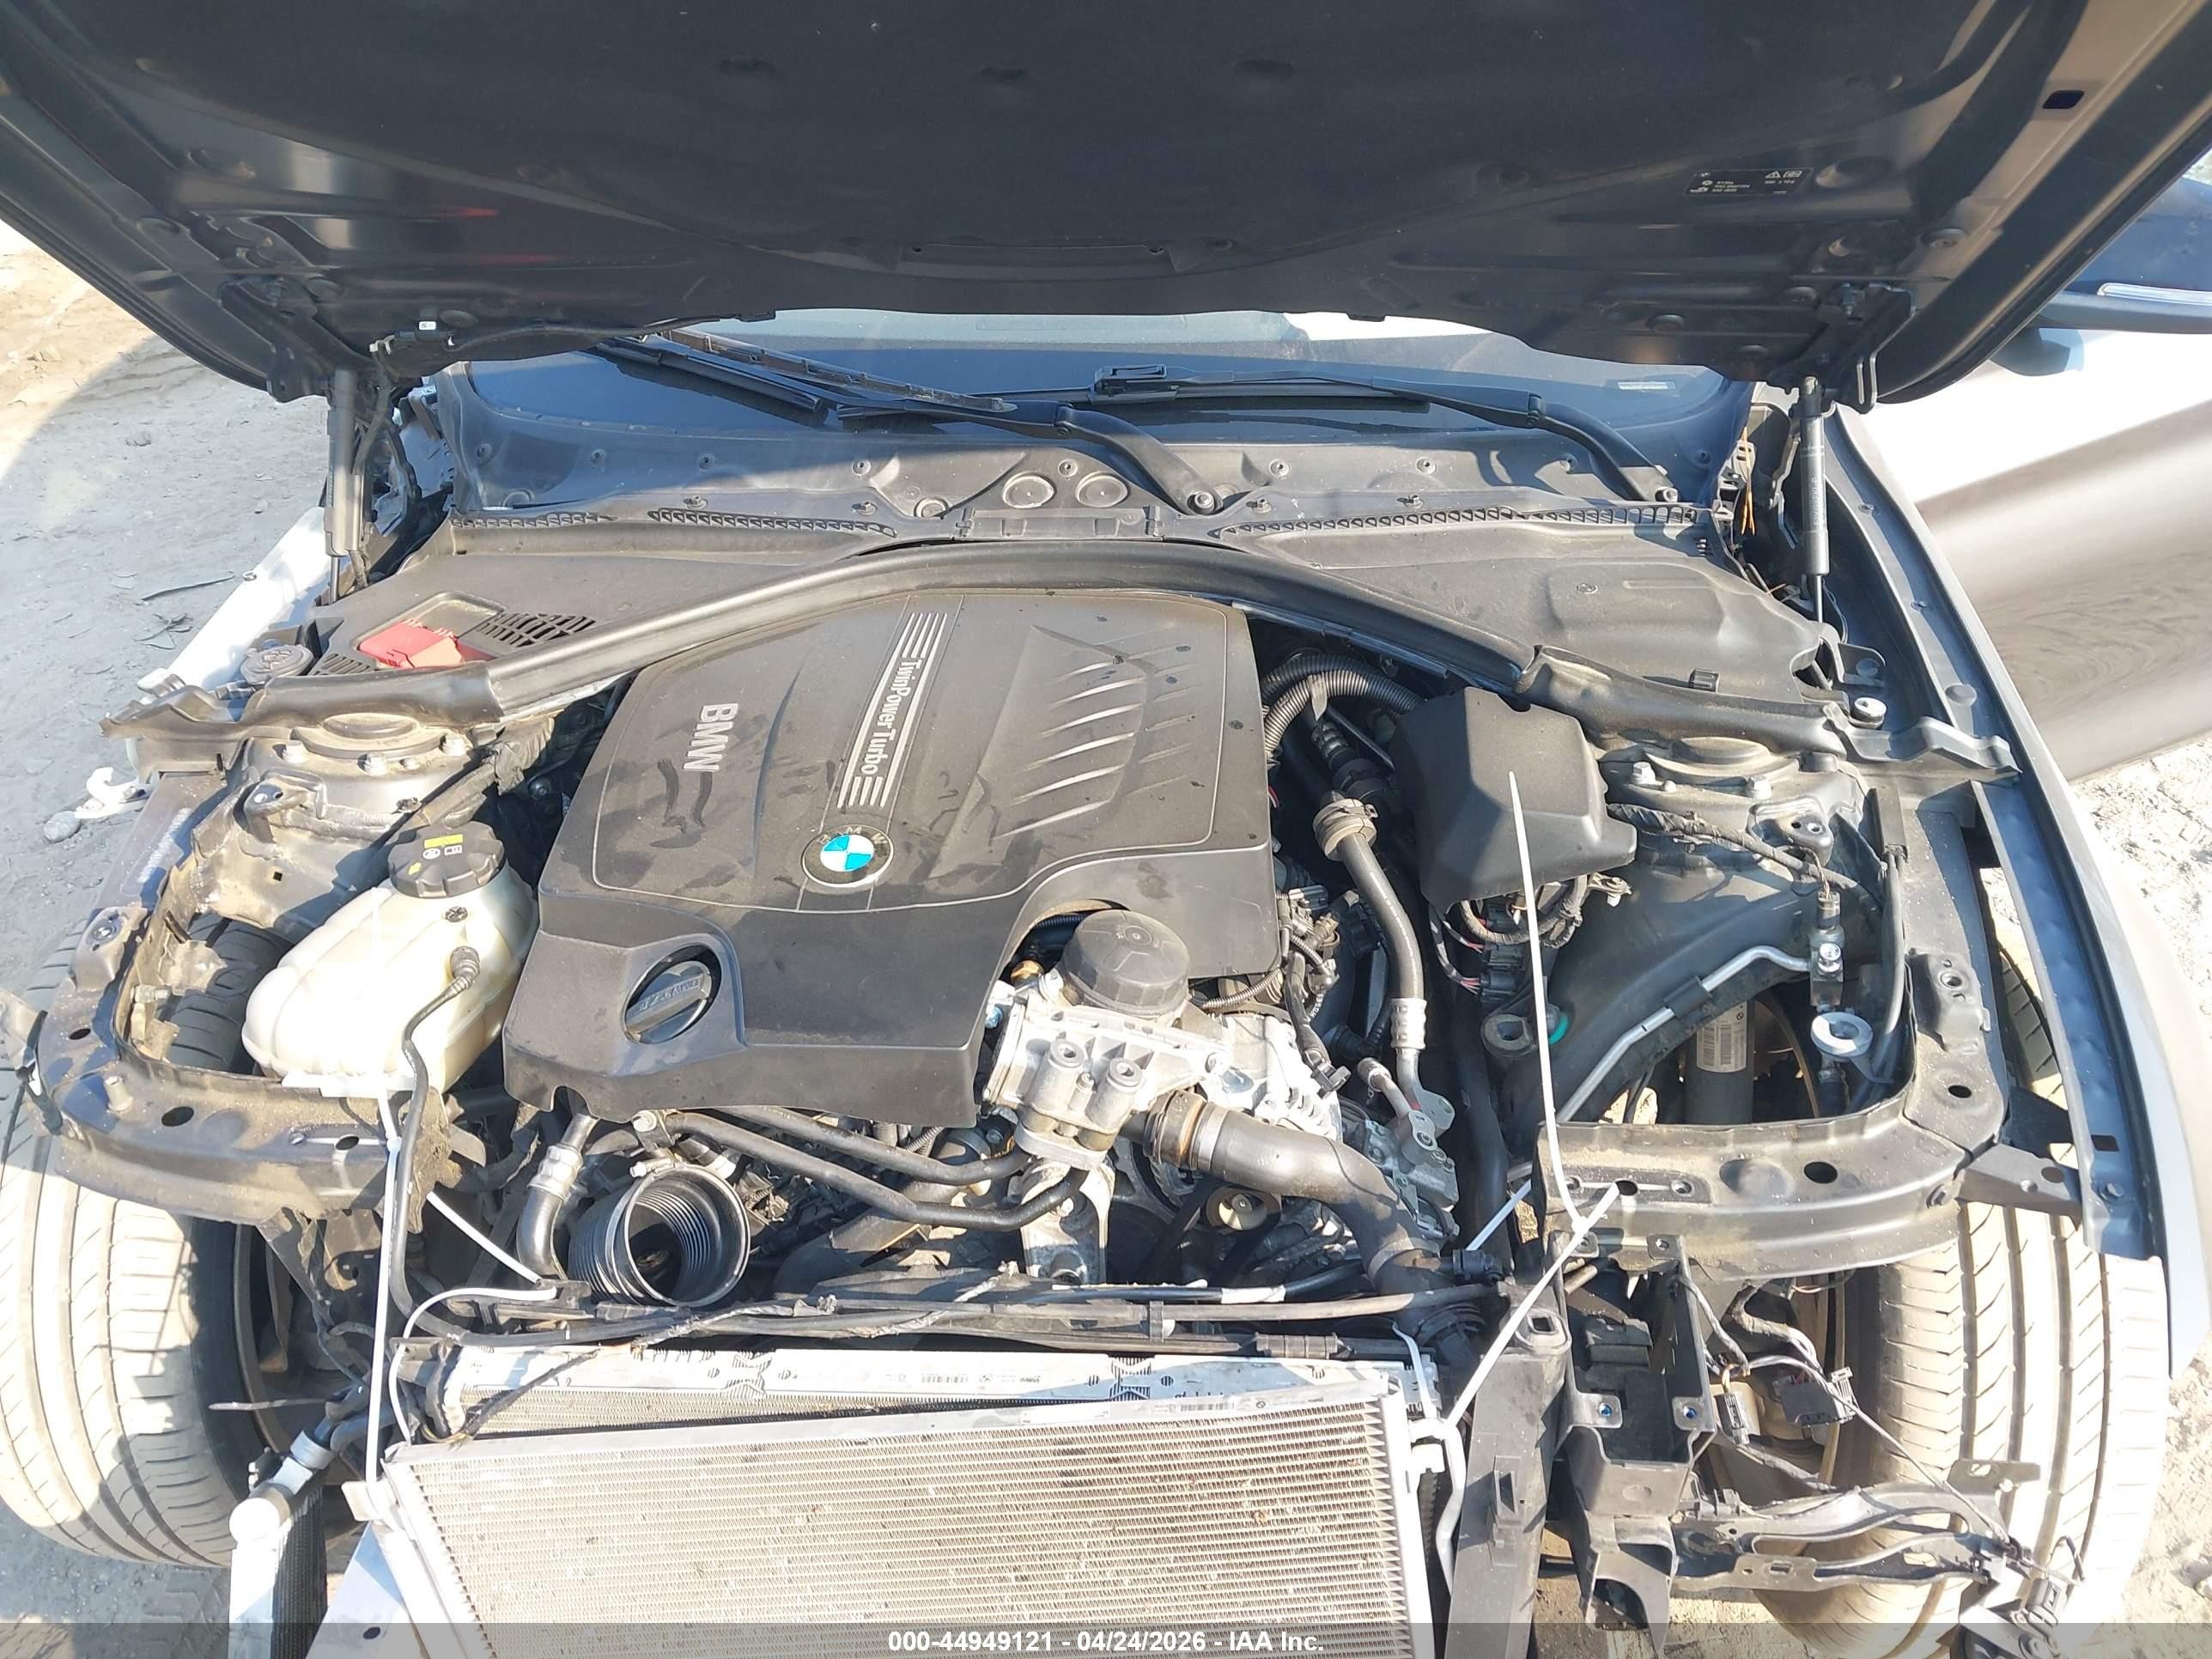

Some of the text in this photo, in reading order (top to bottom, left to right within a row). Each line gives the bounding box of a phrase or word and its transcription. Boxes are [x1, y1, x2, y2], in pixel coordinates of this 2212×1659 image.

[684, 703, 738, 772] BMW
[861, 659, 922, 775] TwinPower Turbo
